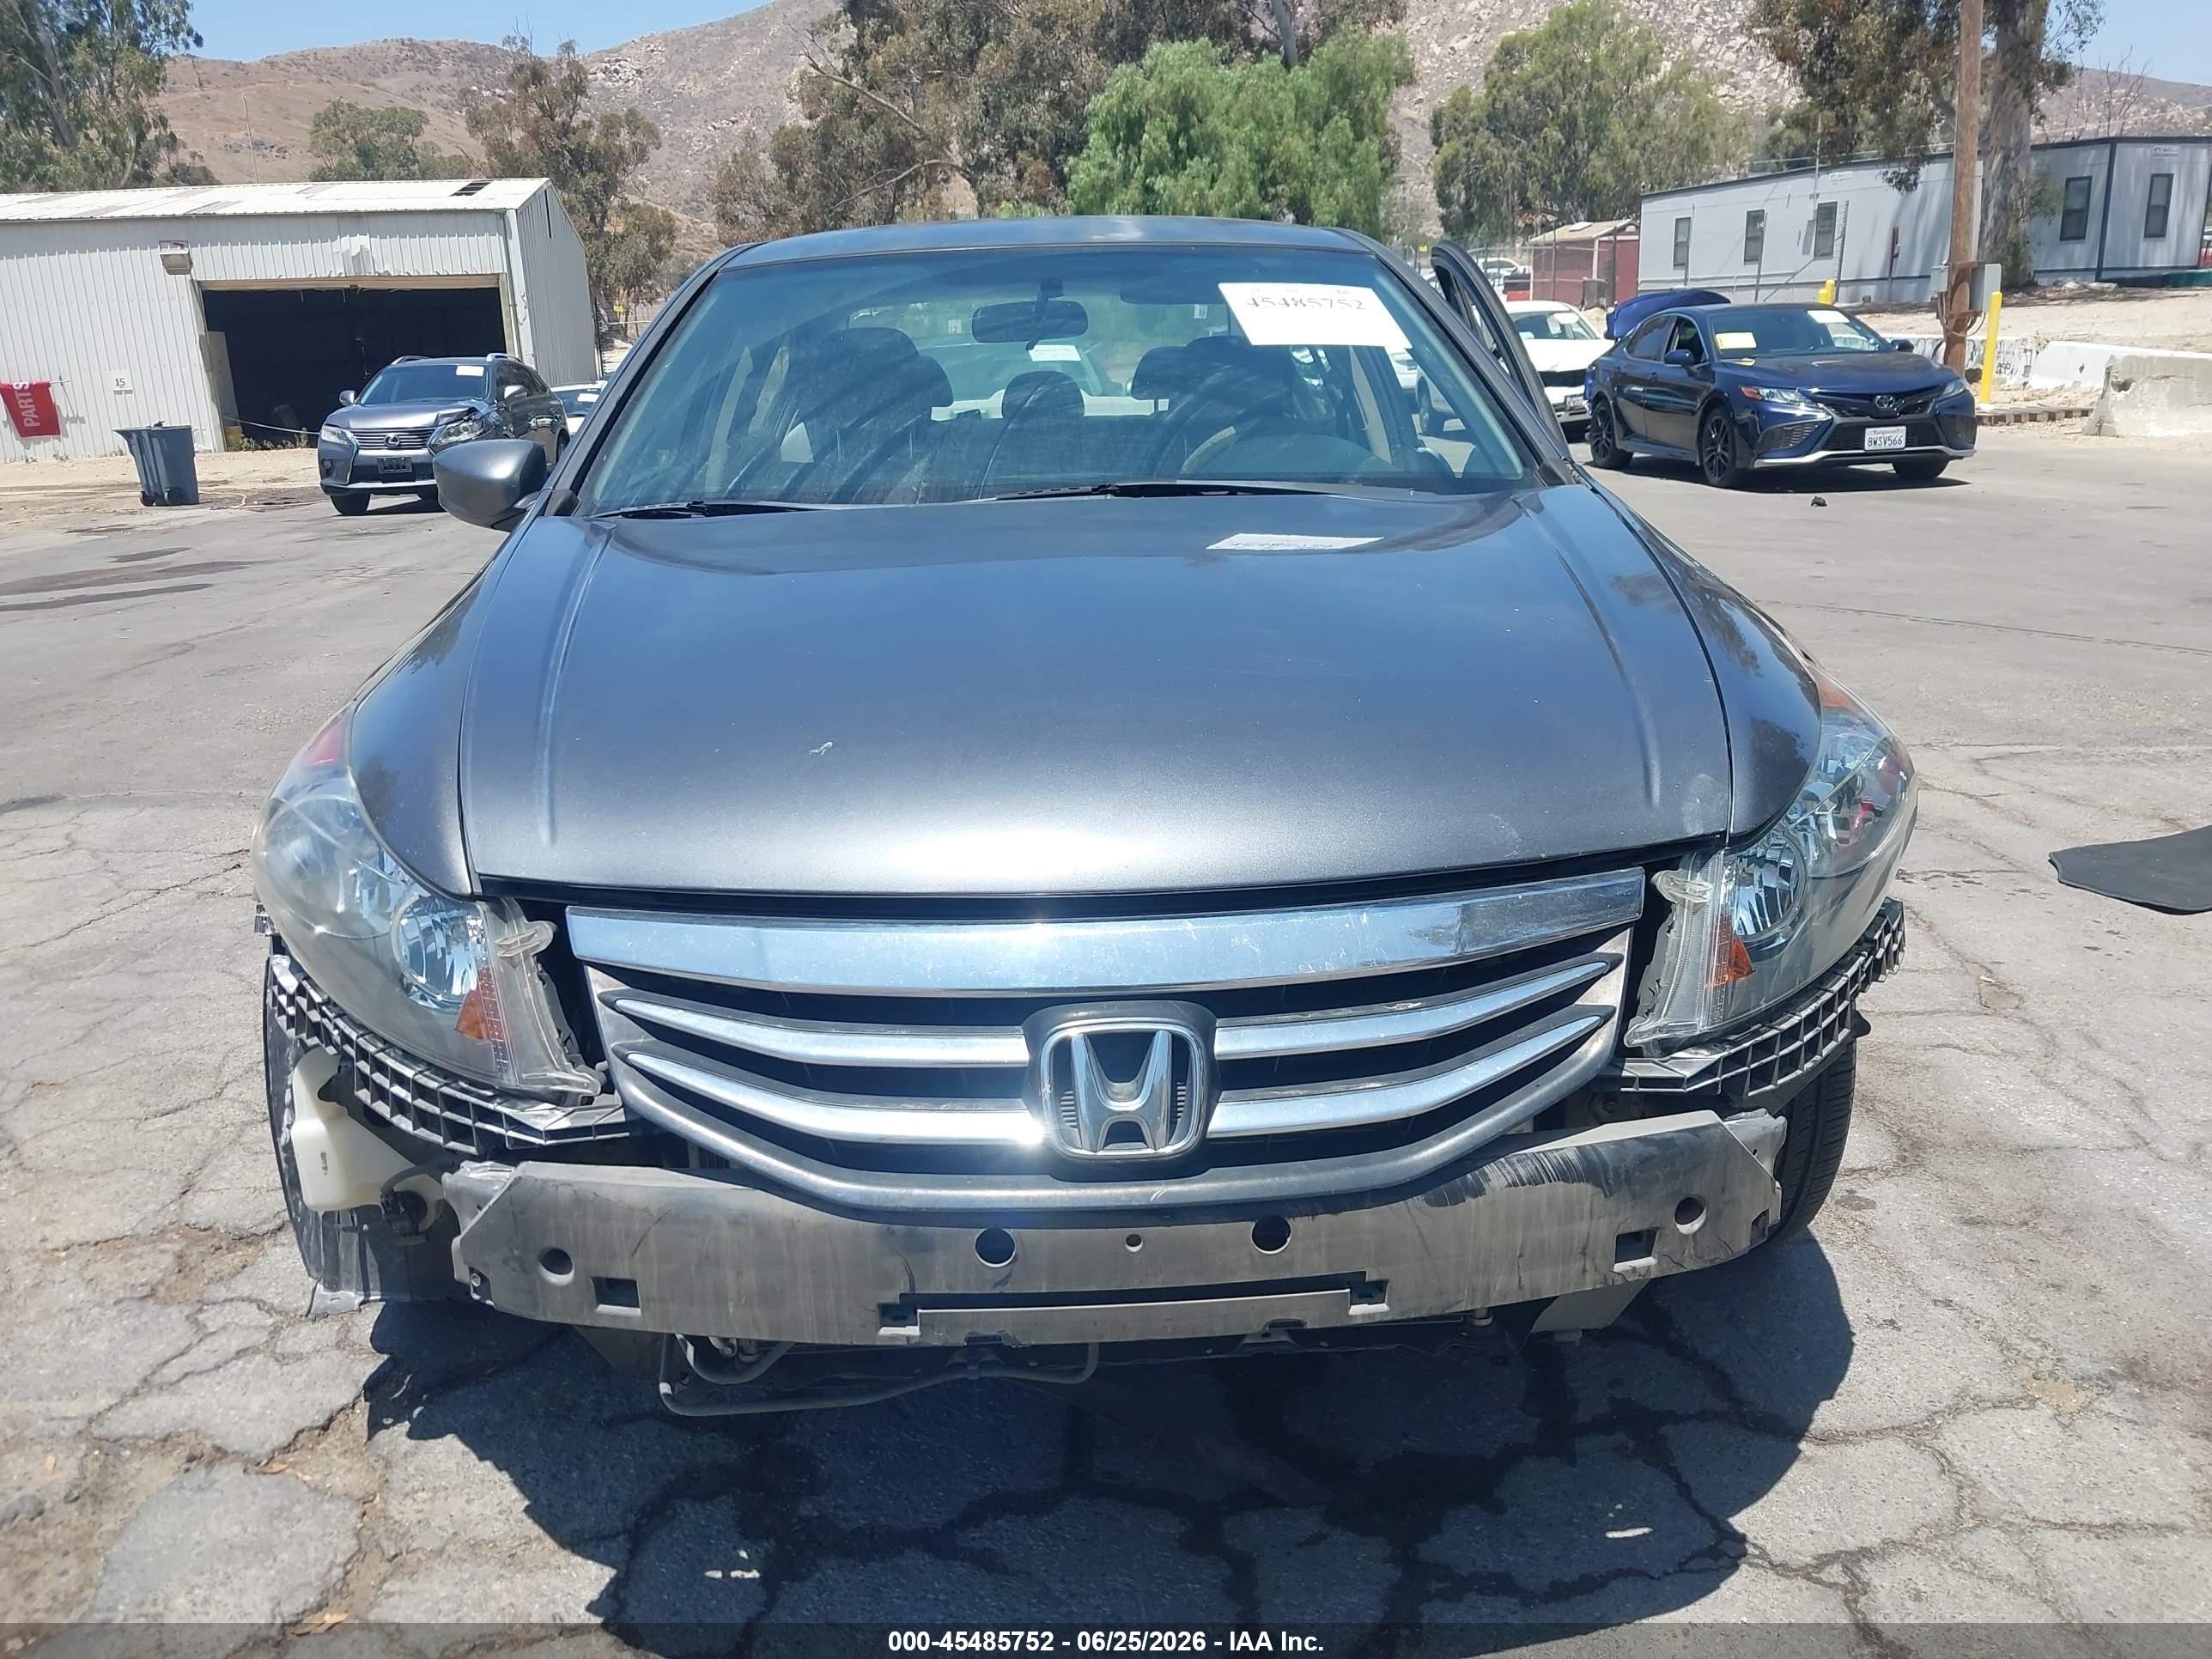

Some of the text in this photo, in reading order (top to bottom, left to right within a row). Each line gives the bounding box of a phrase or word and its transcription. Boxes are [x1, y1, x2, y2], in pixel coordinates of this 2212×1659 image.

[115, 378, 125, 386] 15
[12, 381, 41, 427] PARTS
[1868, 434, 1904, 447] 8WSV566
